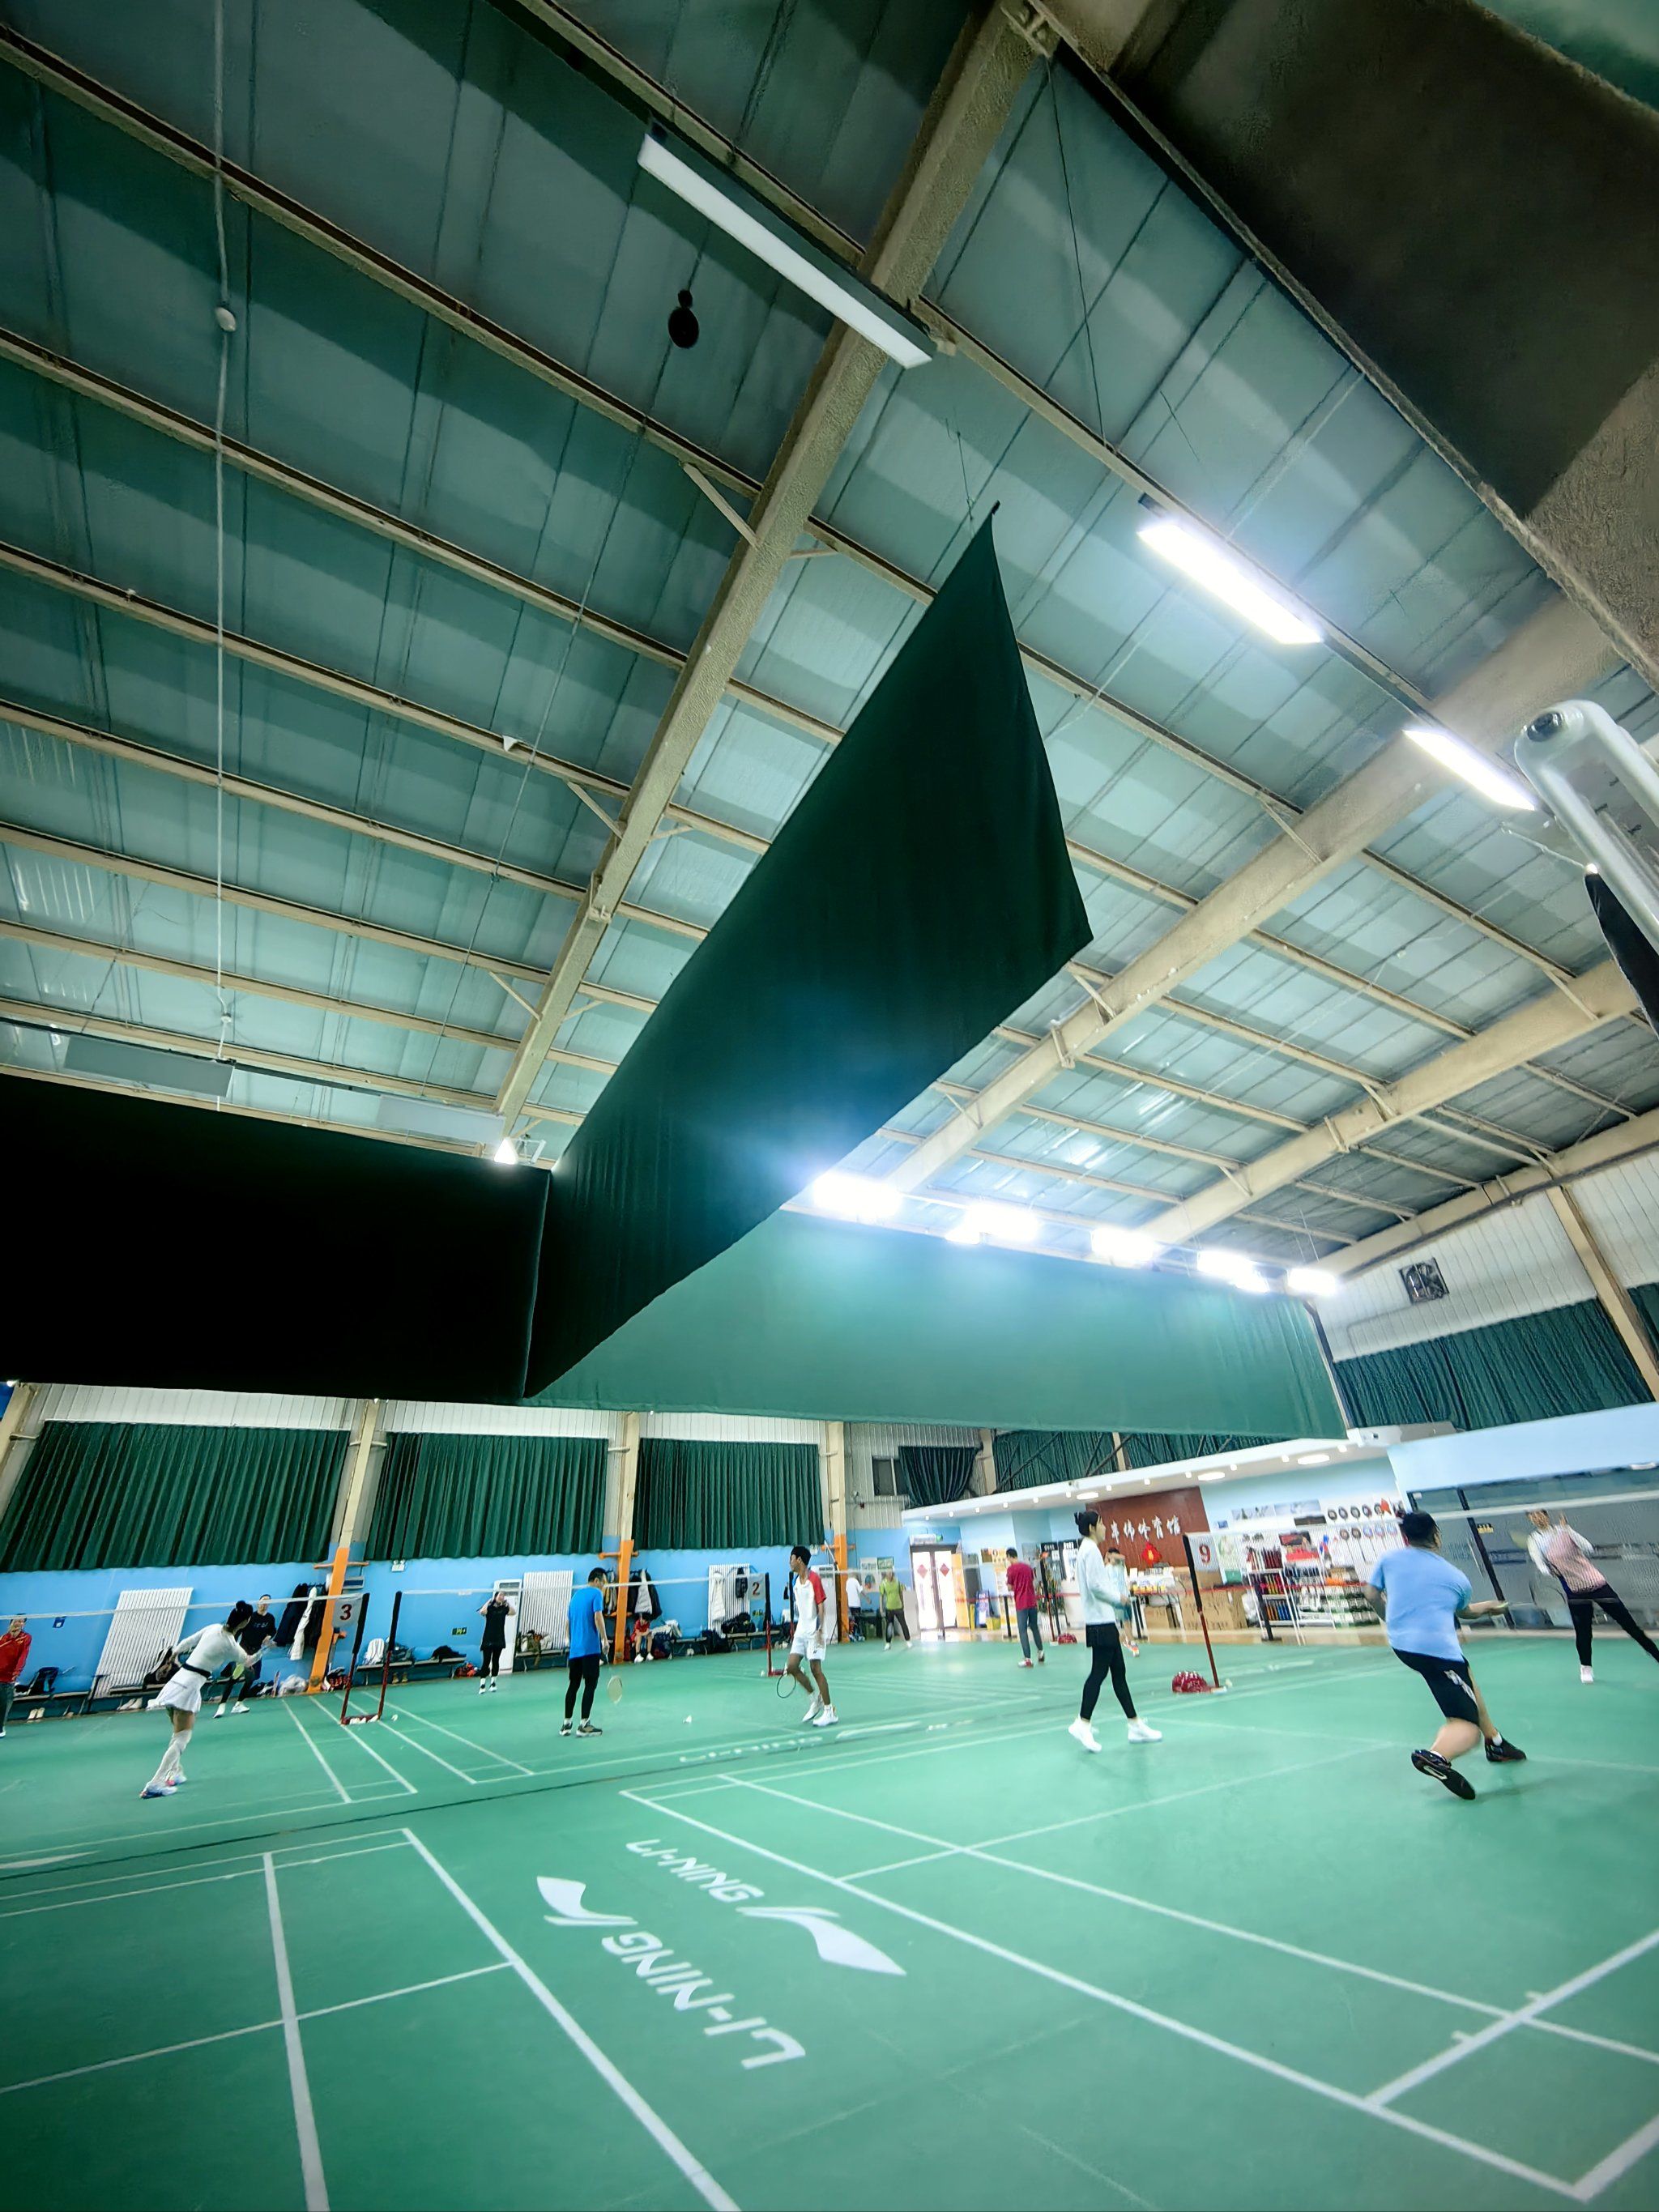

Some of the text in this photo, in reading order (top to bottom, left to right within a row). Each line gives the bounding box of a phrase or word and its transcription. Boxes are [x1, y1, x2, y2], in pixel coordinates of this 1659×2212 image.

[1199, 1543, 1211, 1564] 9
[752, 1581, 761, 1596] 2
[339, 1604, 352, 1621] 3
[626, 1839, 765, 1903] LI-NING
[601, 1931, 806, 2069] LI-NING
